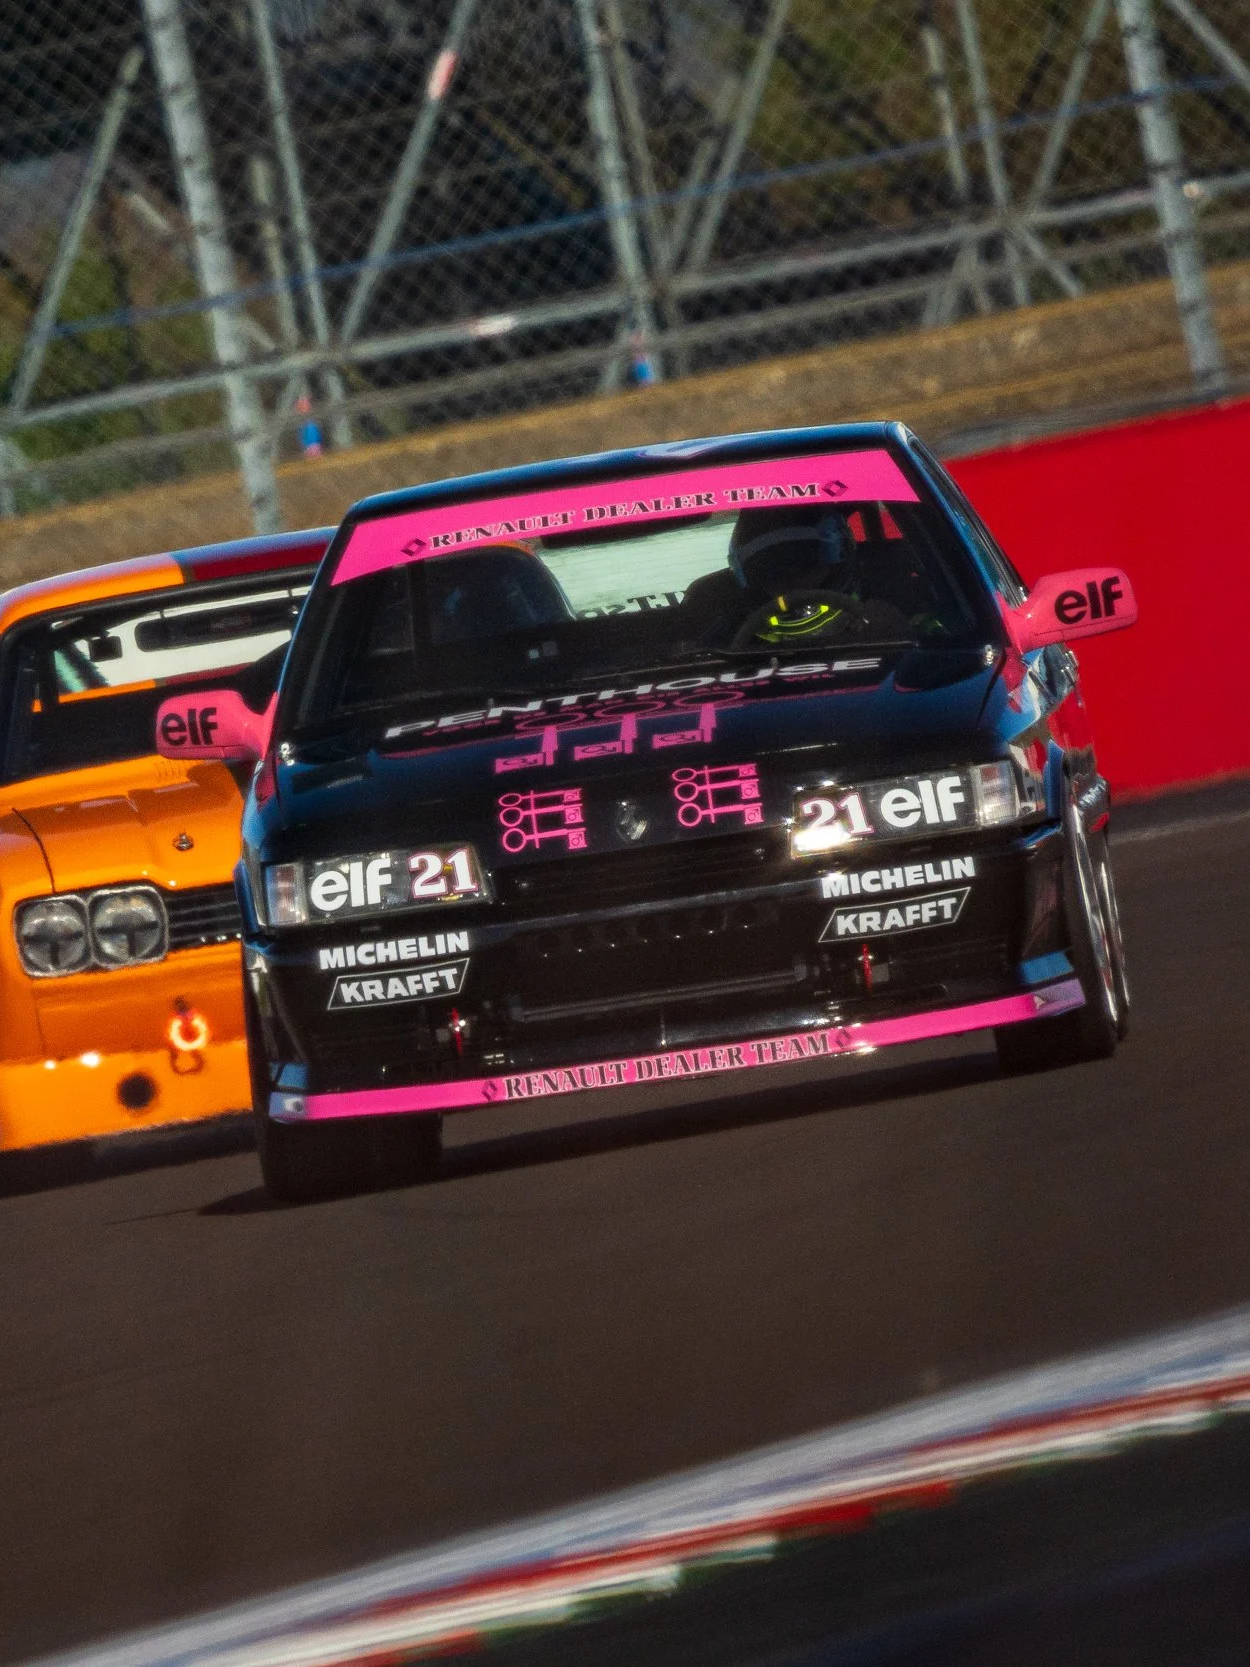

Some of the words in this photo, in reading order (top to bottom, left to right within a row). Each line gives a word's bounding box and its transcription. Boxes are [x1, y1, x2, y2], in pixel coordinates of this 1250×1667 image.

[430, 511, 575, 549] RENAULT
[583, 492, 716, 521] DEALER
[723, 483, 819, 502] TEAM
[1055, 576, 1123, 624] elf
[385, 658, 881, 739] PENTHOUSE
[161, 707, 218, 746] elf
[803, 791, 874, 838] 21
[880, 776, 965, 828] elf
[310, 858, 392, 911] elf
[408, 848, 478, 898] 21
[821, 856, 976, 898] MICHELIN
[837, 898, 957, 936] KRAFFT
[319, 931, 470, 970] MICHELIN
[341, 968, 458, 1003] KRAFFT
[503, 1062, 627, 1099] RENAULT
[634, 1046, 747, 1081] DEALER
[750, 1032, 832, 1064] TEAM
